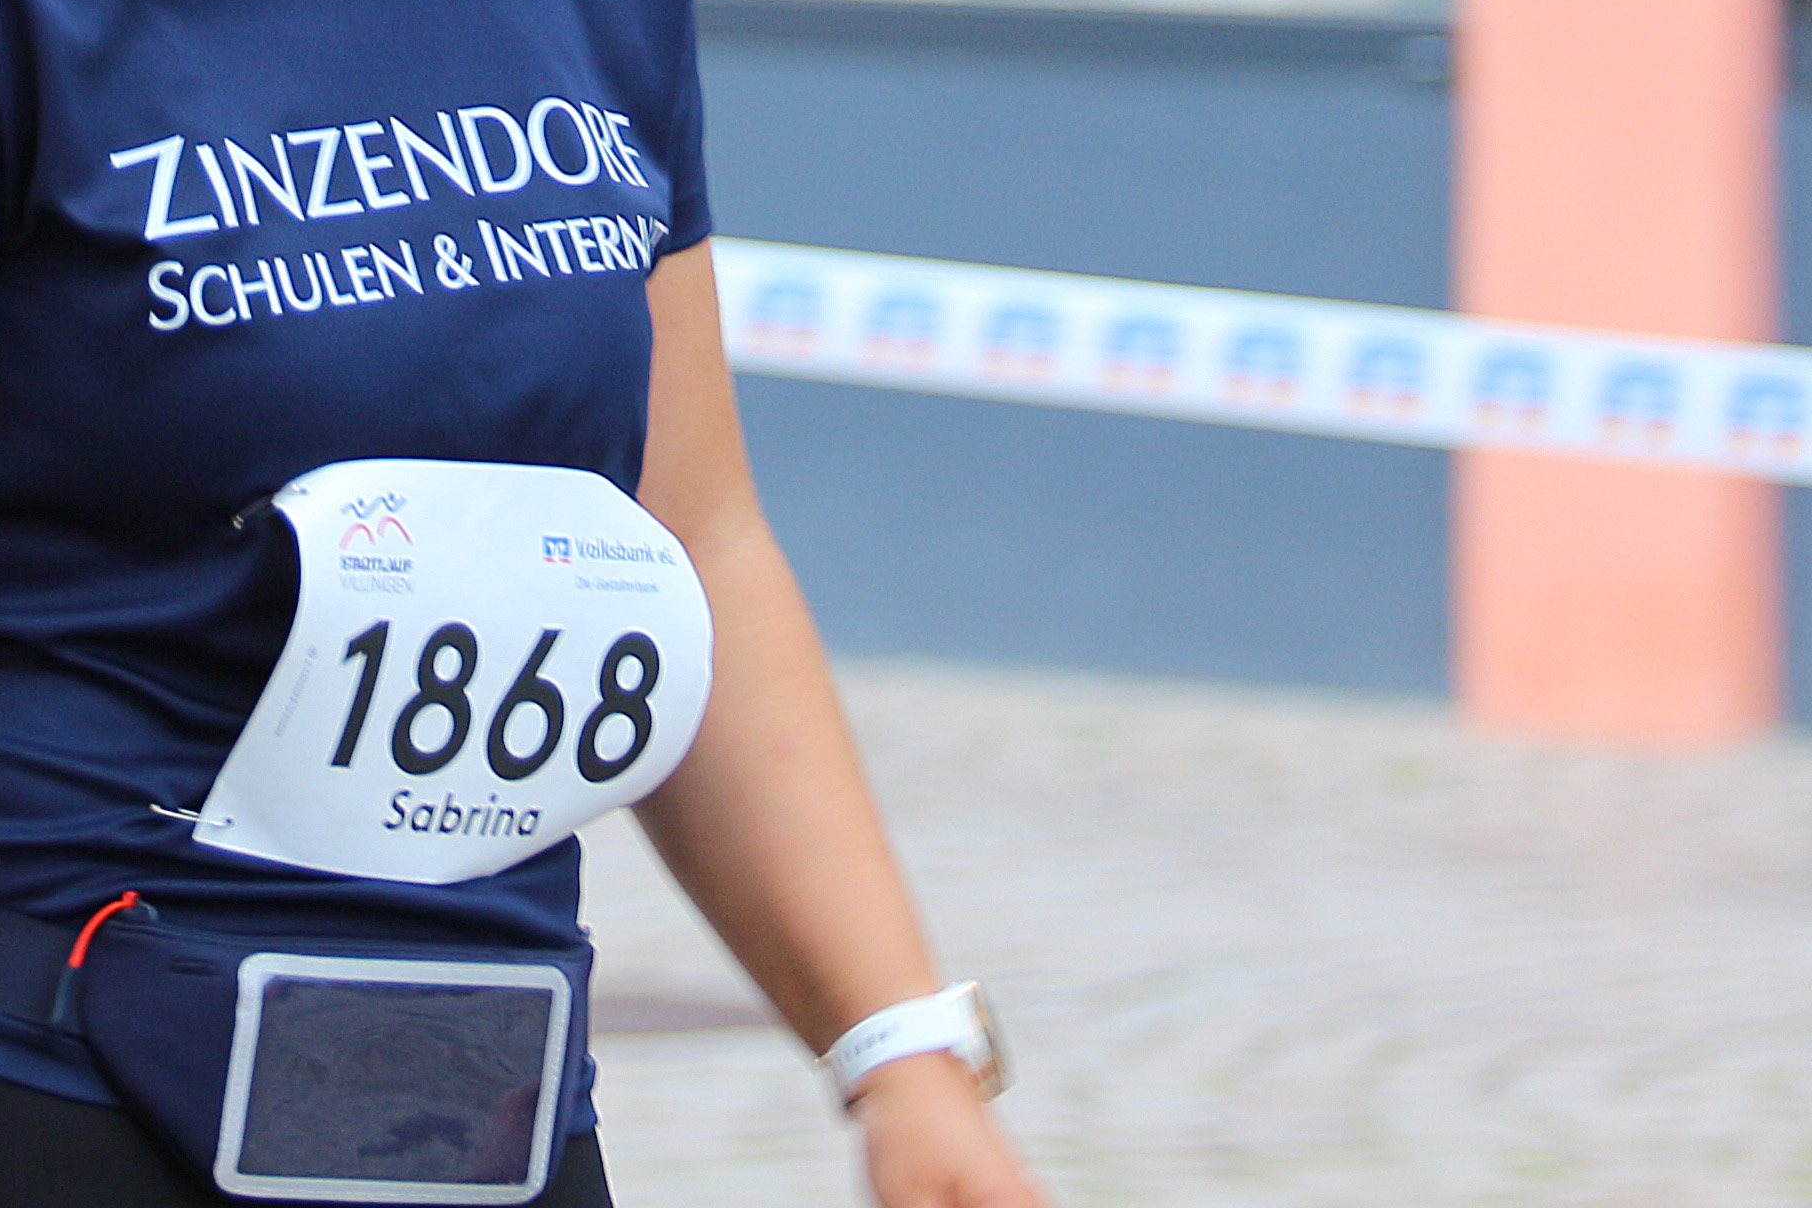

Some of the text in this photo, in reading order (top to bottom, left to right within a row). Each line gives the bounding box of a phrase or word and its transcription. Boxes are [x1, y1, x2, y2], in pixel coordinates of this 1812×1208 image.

[109, 96, 649, 240] ZINZENDORF
[148, 241, 424, 330] SCHULEN
[432, 234, 480, 290] &
[330, 619, 662, 784] 1868
[383, 788, 541, 837] Sabrina
